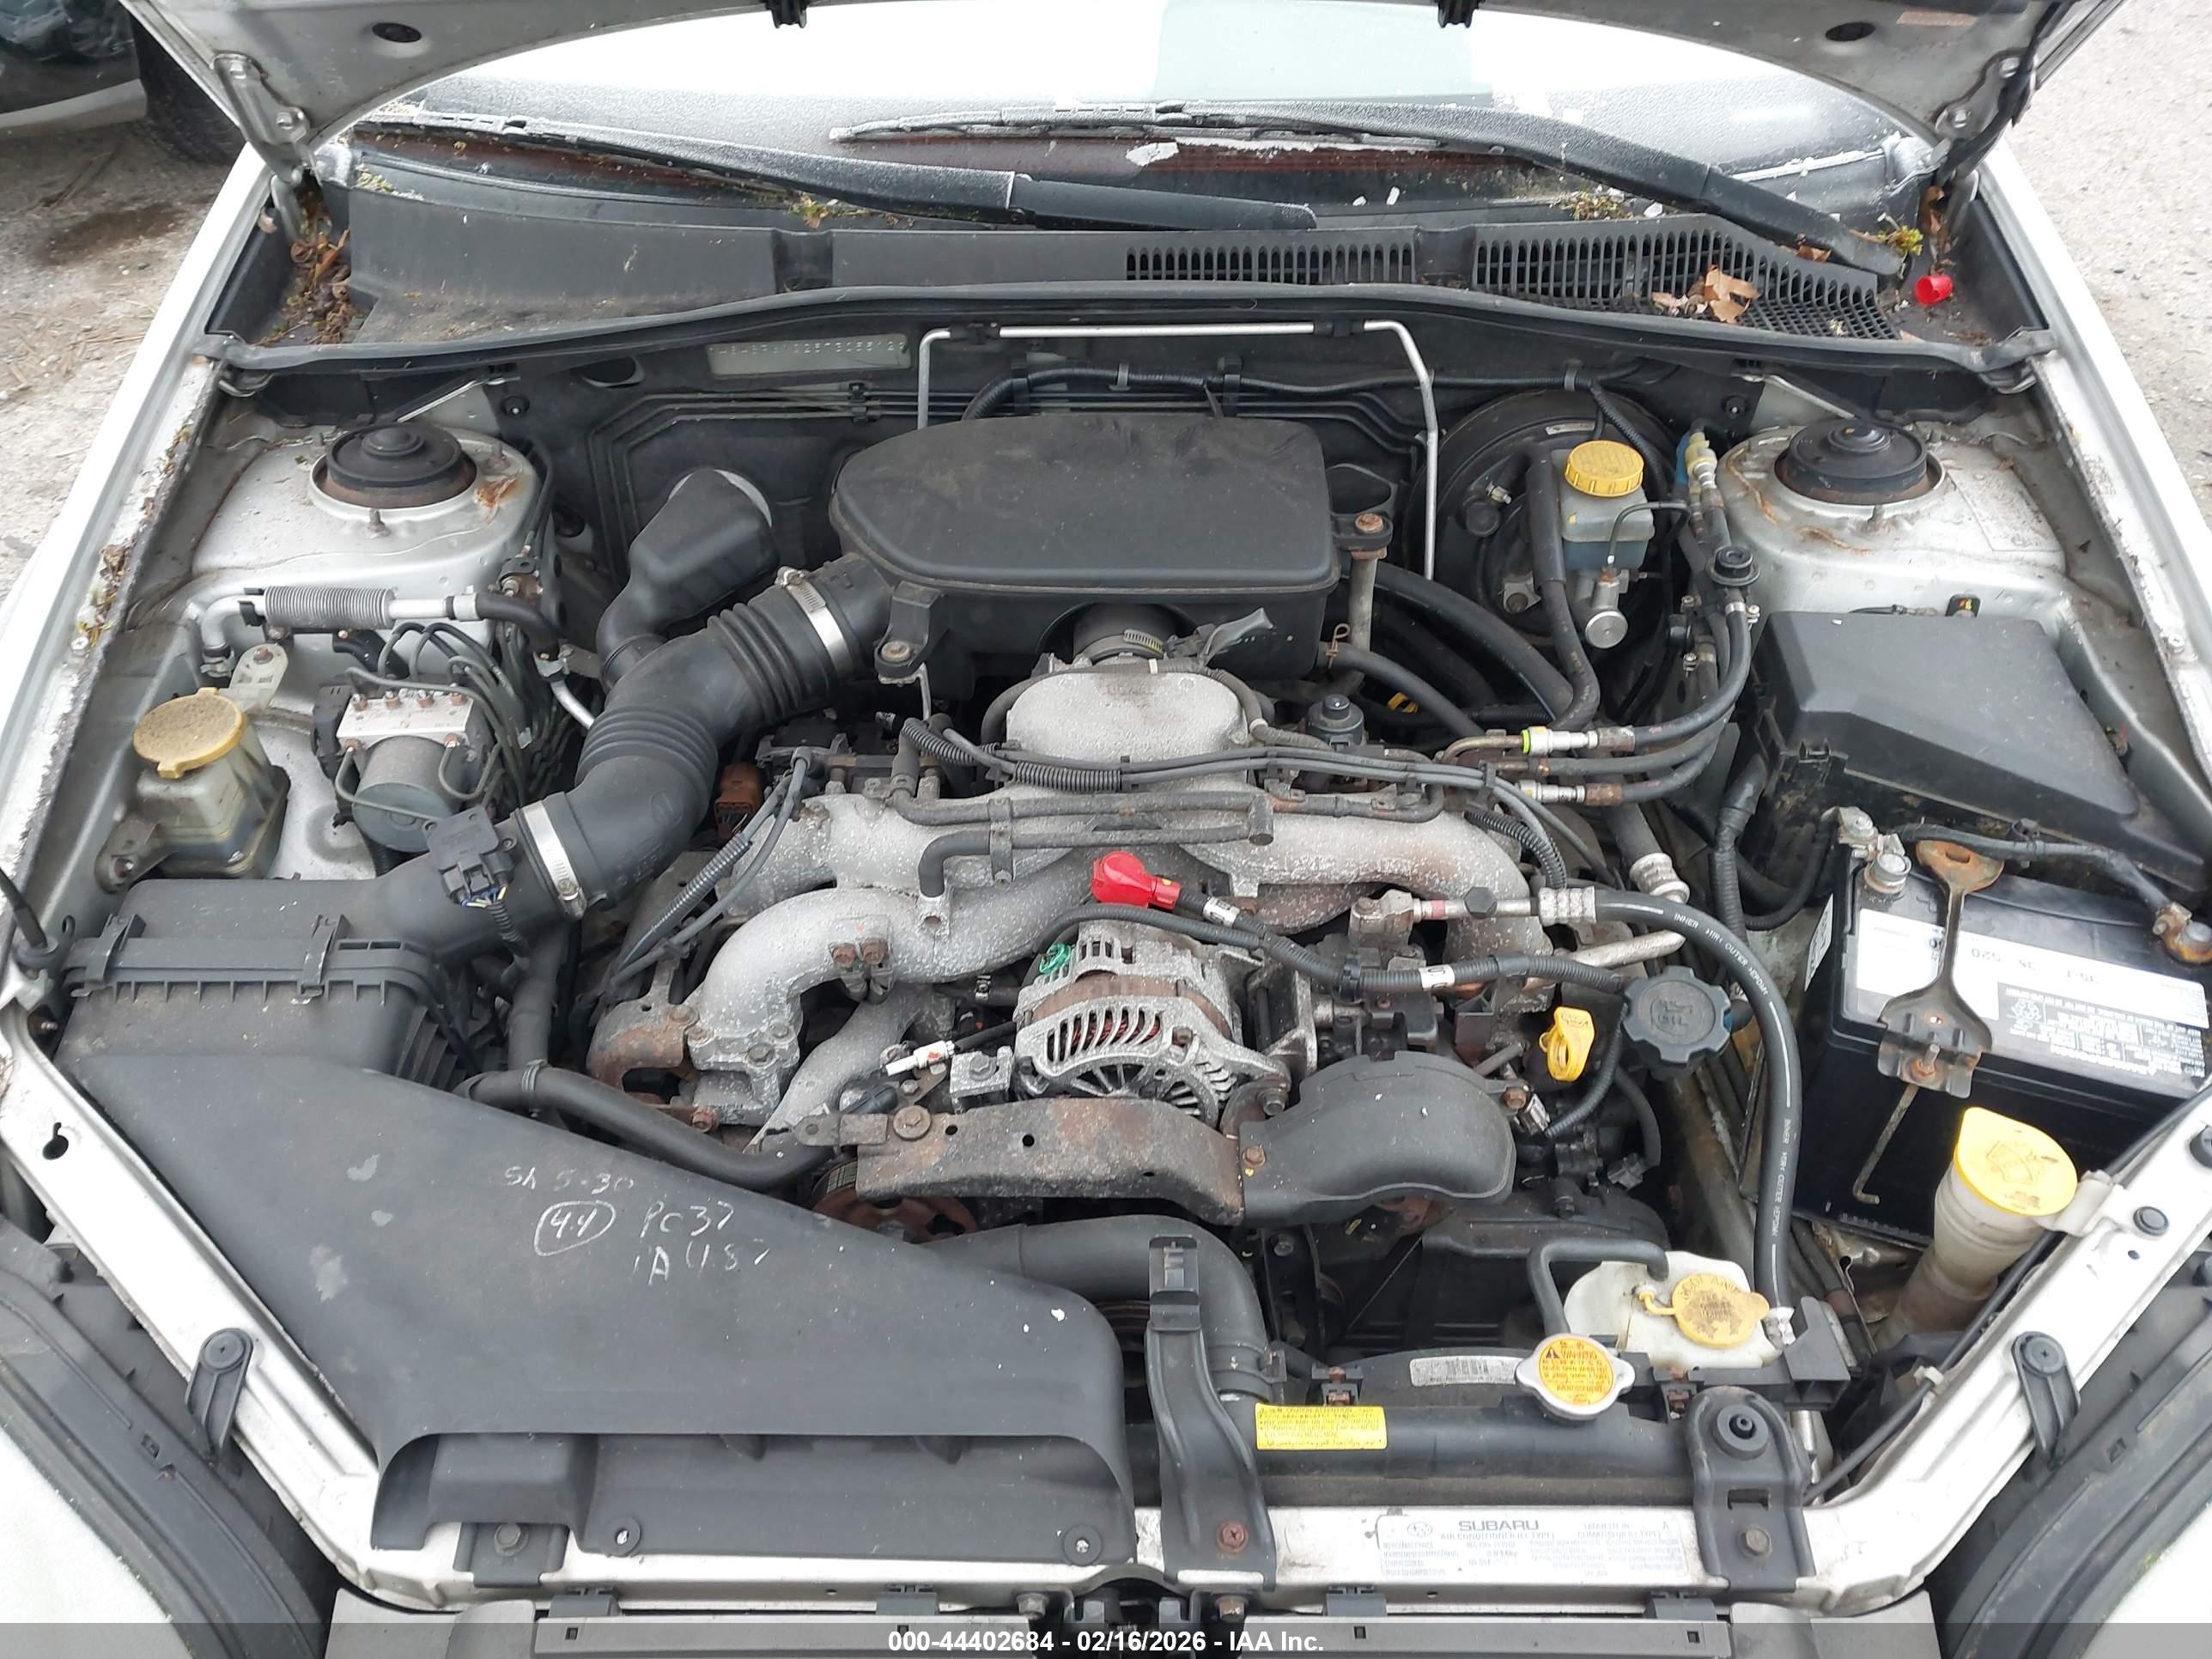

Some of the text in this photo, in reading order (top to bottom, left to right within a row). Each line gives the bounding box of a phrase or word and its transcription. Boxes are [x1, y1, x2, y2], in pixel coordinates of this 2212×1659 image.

[1674, 912, 1699, 929] INNER
[1724, 942, 1749, 968] OUTER
[1774, 1174, 1785, 1203] OUTER
[1458, 1519, 1540, 1532] SUBARU
